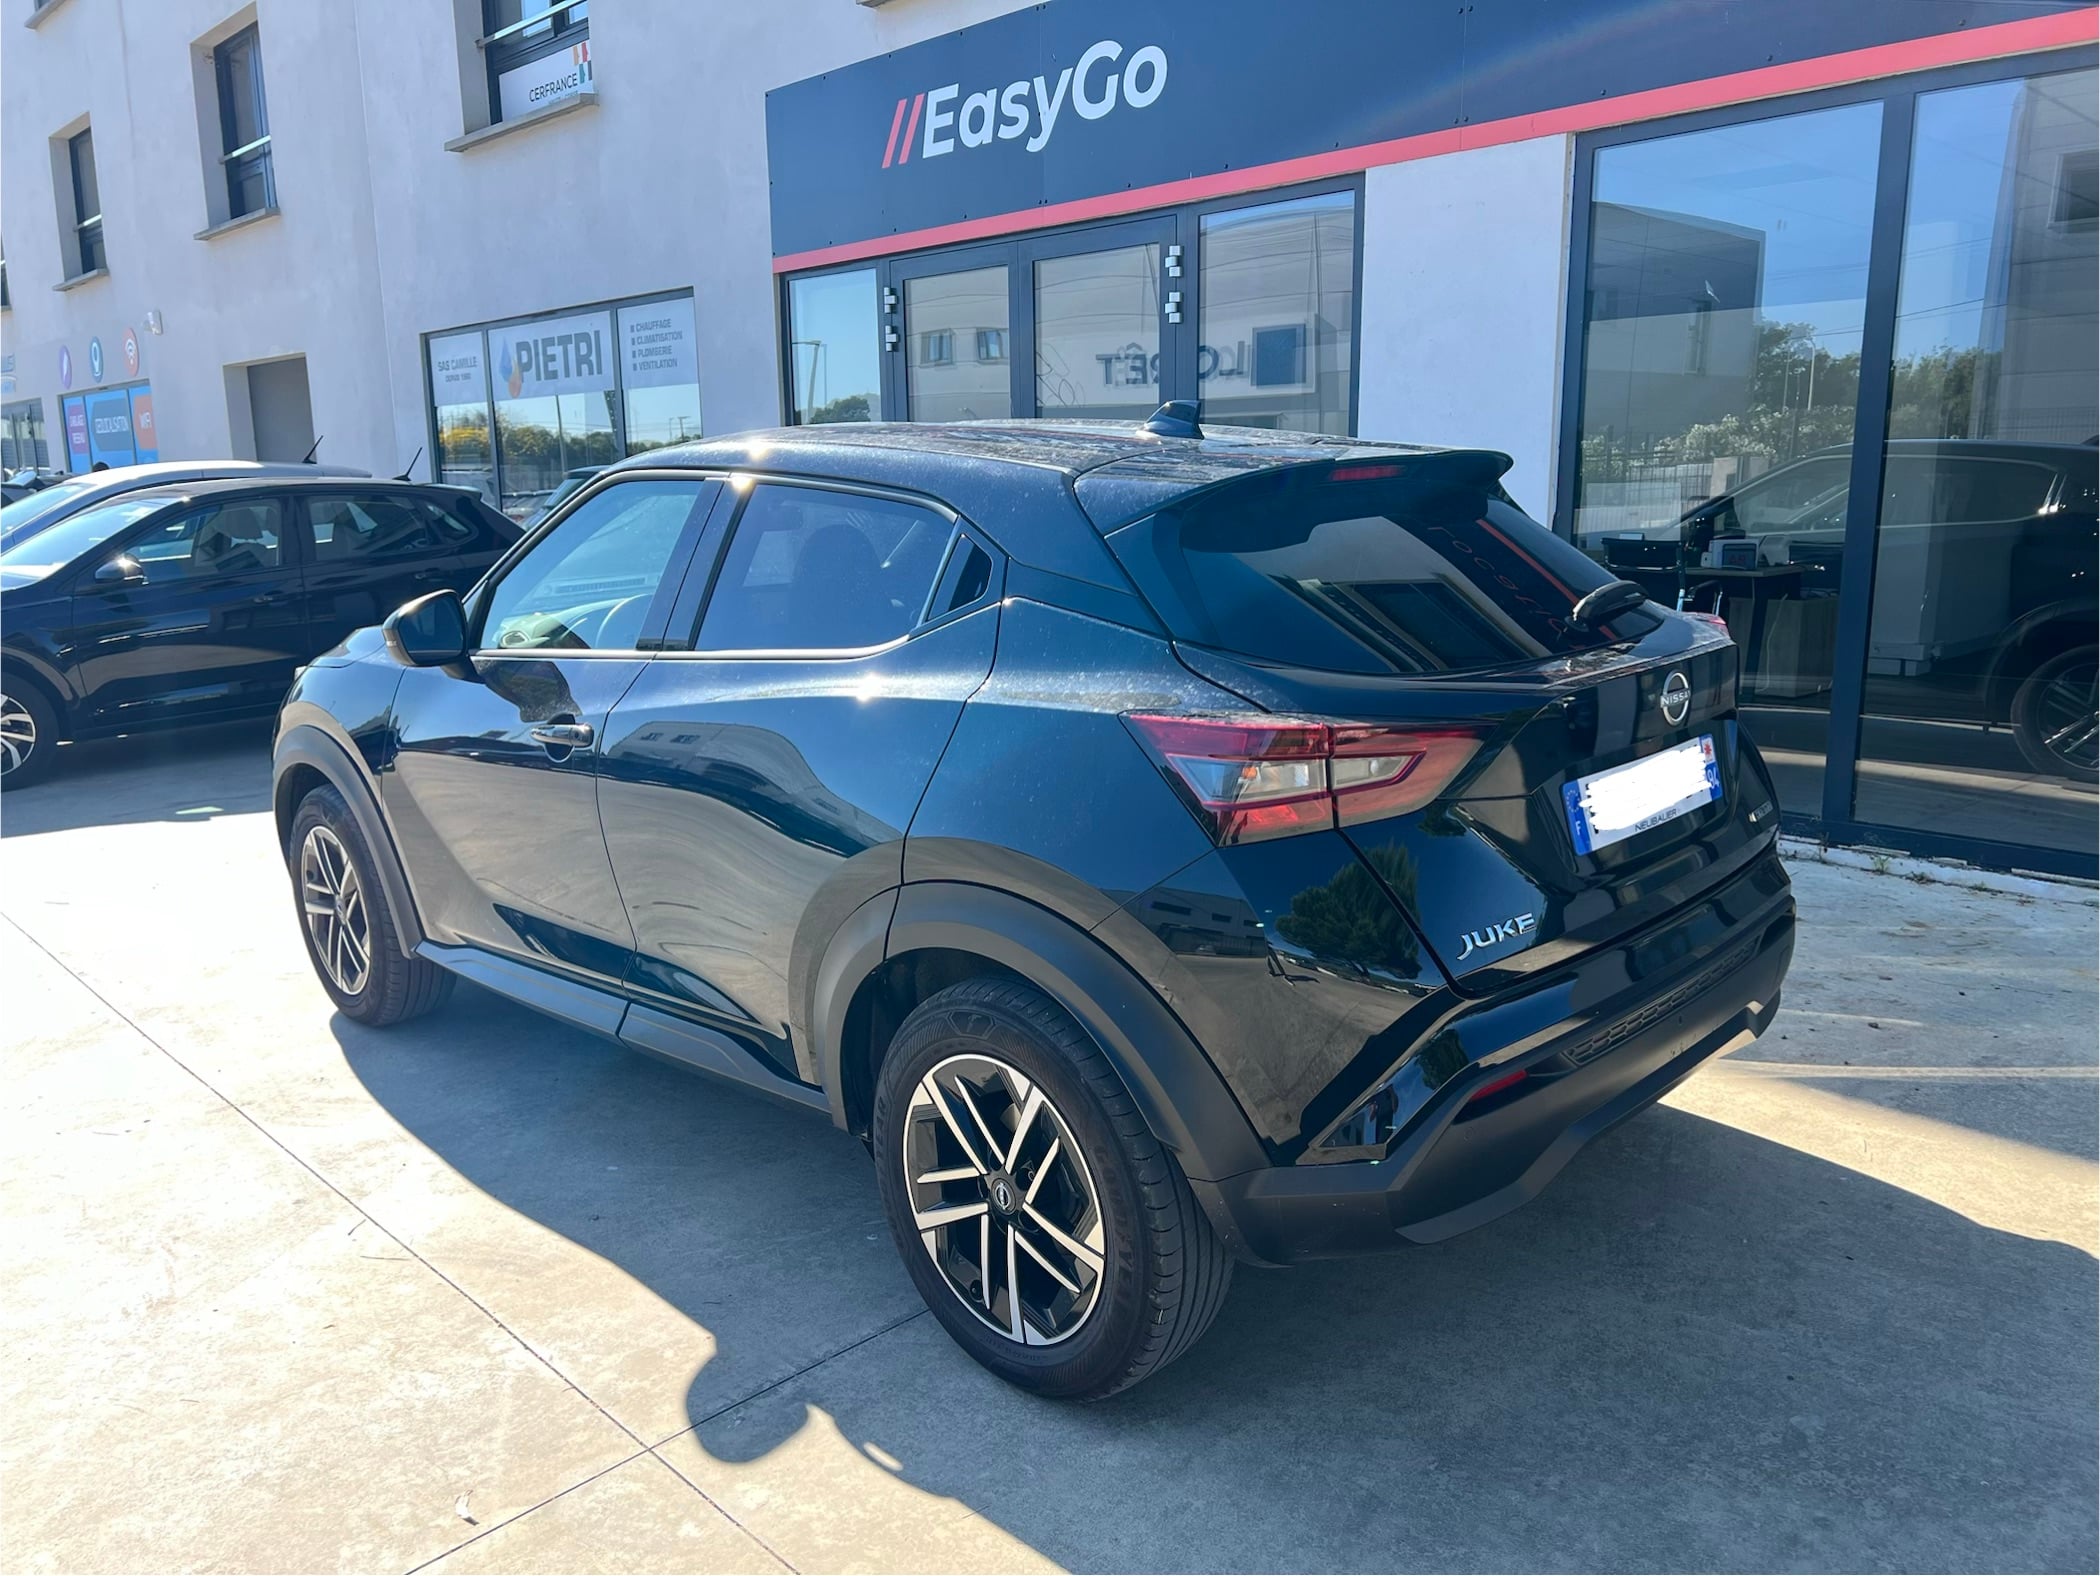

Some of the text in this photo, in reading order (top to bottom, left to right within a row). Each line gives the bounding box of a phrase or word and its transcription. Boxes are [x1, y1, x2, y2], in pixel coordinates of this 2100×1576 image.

[528, 73, 578, 103] CERFRANCE
[922, 40, 1168, 159] EasyGo
[636, 318, 672, 332] CHAUFFAGE
[637, 330, 683, 345] CLIMATISATION
[515, 329, 604, 383] PIETRI
[638, 345, 672, 358] PLOMBERIE
[437, 360, 450, 372] SAS
[638, 358, 678, 371] VENTILATION
[1706, 766, 1720, 789] 94
[1575, 820, 1582, 835] F
[1634, 808, 1678, 832] NEUBAUER
[1457, 911, 1537, 961] JUKE
